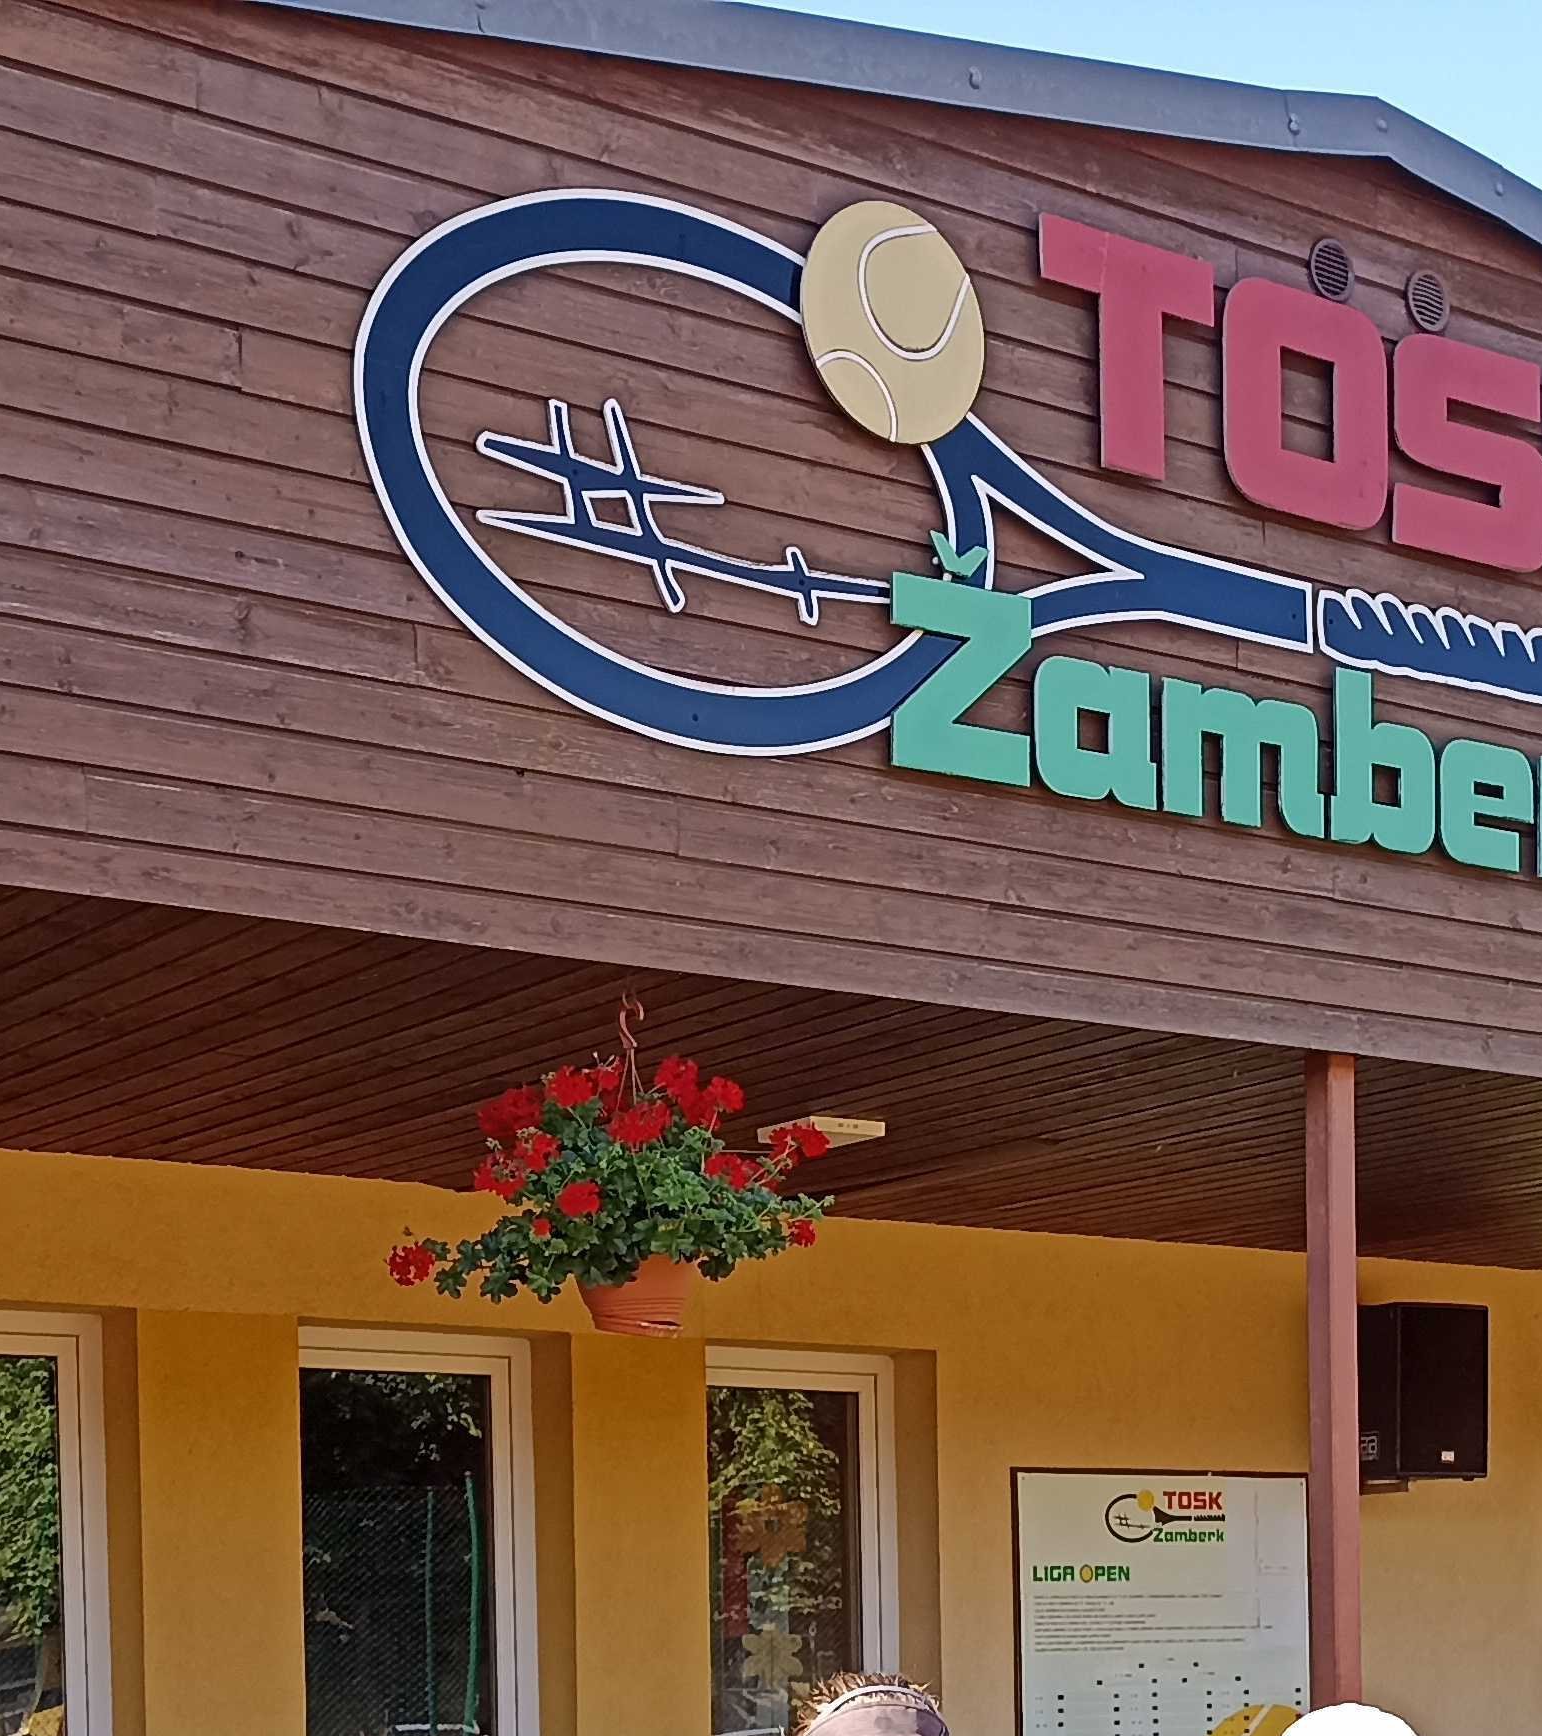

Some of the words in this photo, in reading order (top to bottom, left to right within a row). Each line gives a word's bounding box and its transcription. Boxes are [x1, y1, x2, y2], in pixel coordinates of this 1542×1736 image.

[1162, 1490, 1223, 1511] TOSK
[1032, 1565, 1075, 1582] LIGA
[1079, 1564, 1131, 1583] OPEN
